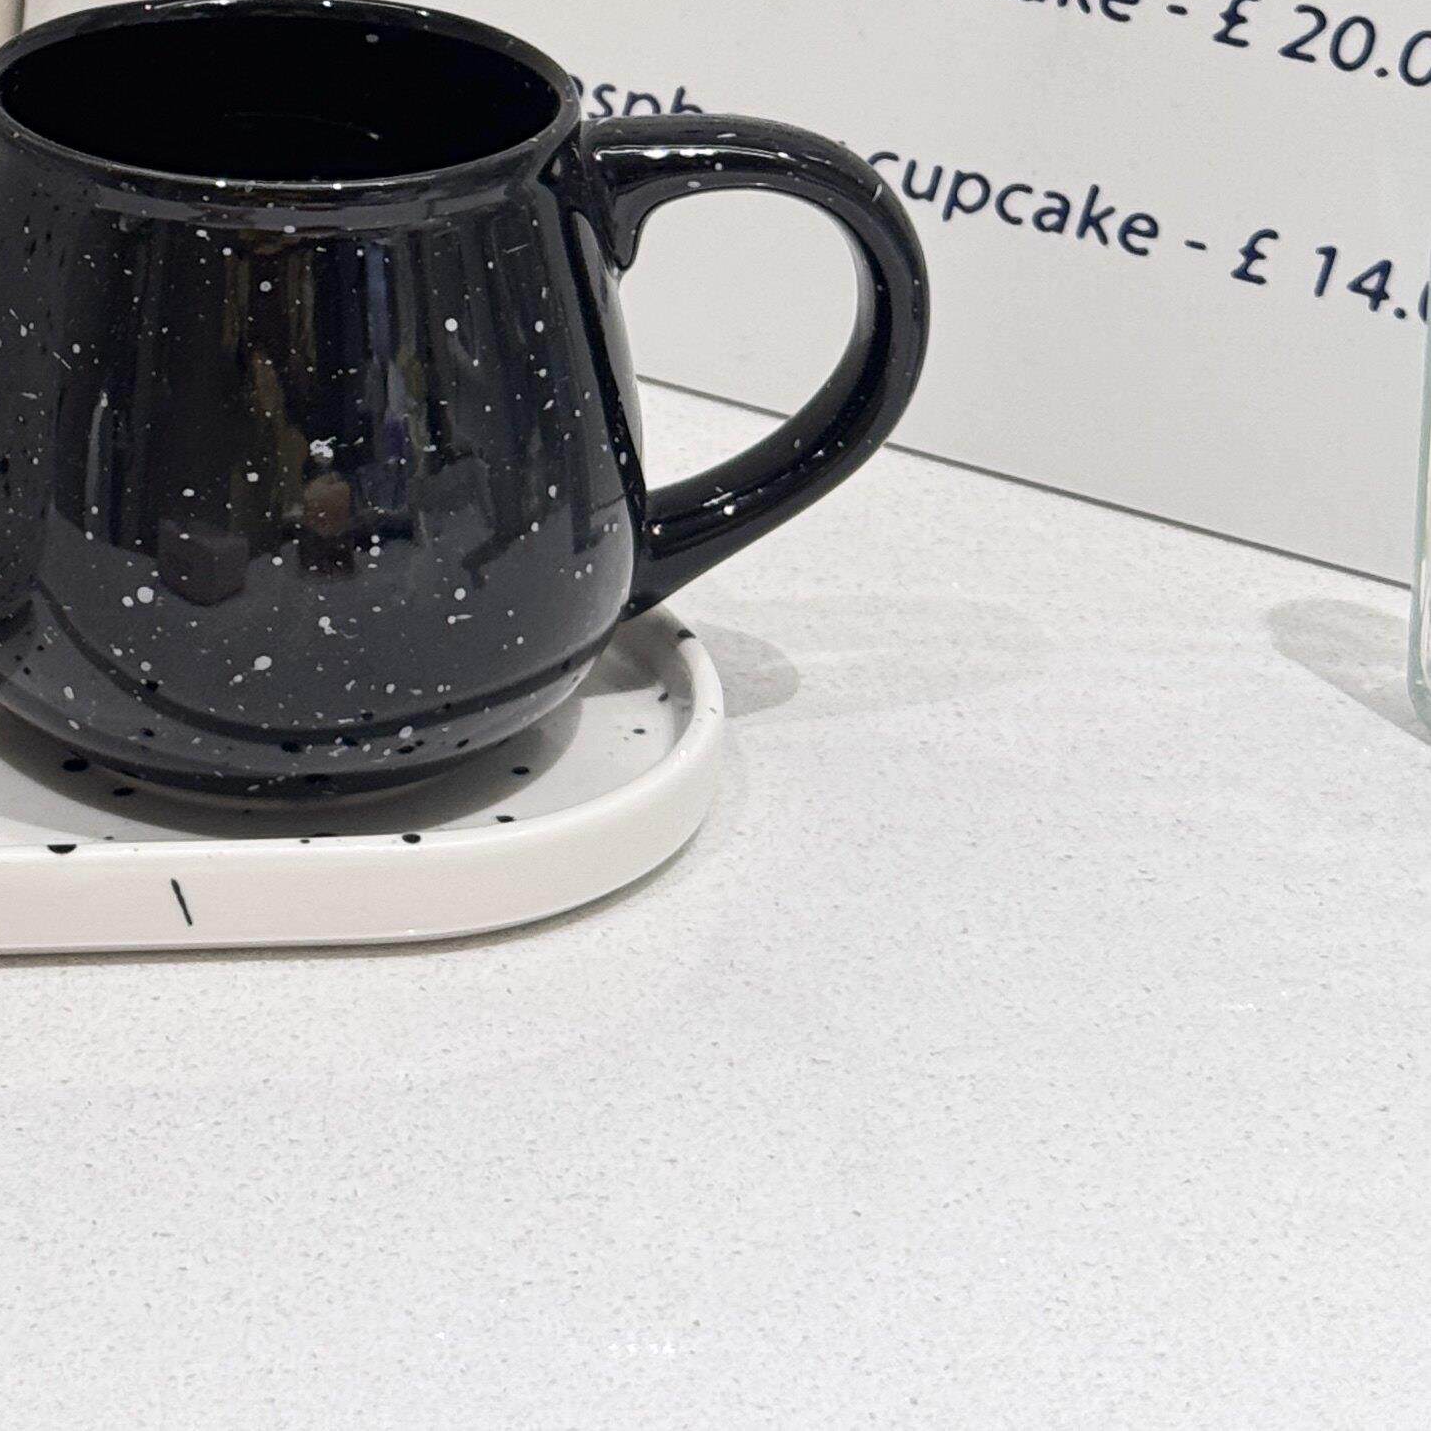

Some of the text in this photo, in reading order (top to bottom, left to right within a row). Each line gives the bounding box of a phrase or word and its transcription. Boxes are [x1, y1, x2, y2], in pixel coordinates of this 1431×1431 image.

[1277, 3, 1431, 88] 20.0
[1229, 227, 1281, 287] £
[1313, 244, 1430, 323] 14.
